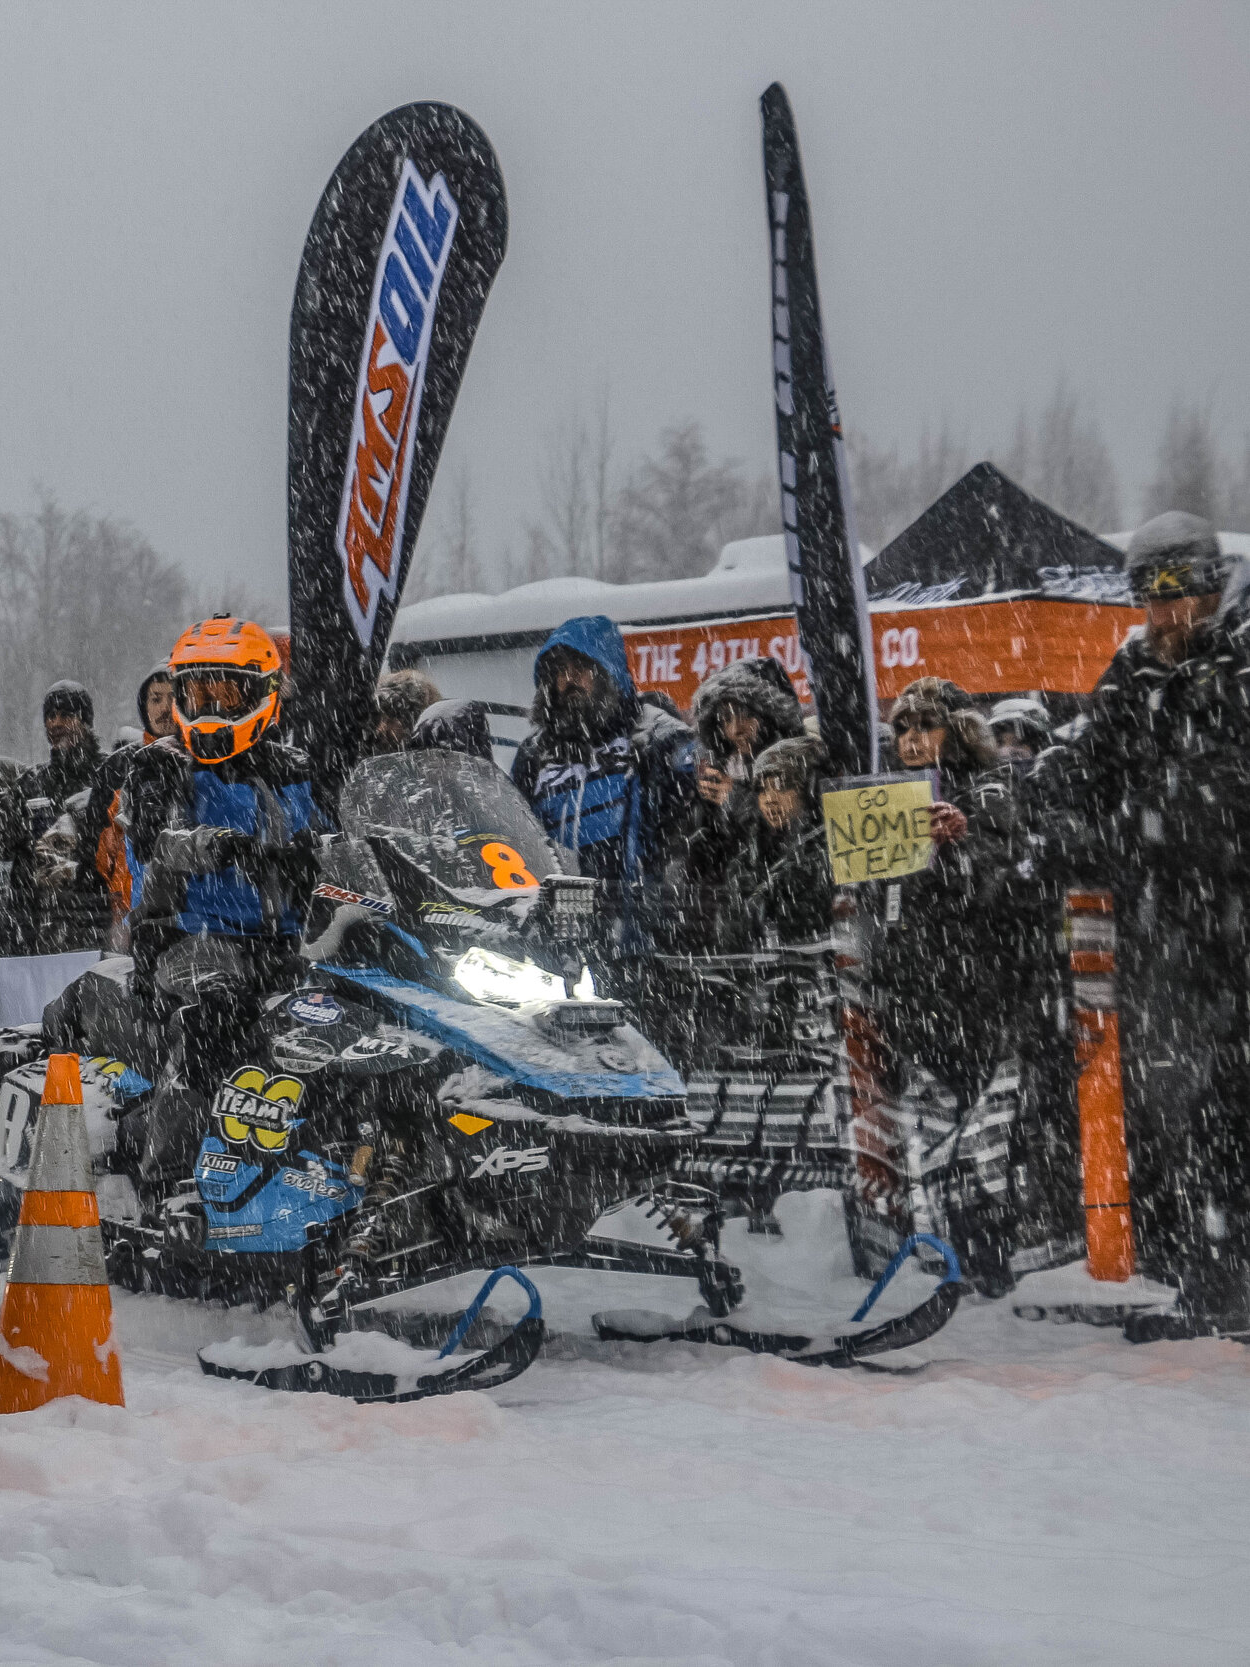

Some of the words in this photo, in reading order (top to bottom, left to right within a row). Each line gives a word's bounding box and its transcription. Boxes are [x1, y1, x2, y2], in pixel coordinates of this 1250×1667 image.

[337, 162, 456, 646] AMSOIL
[633, 643, 683, 684] THE
[880, 627, 927, 668] CO.
[857, 789, 888, 810] GO
[830, 806, 931, 852] NOME
[480, 842, 540, 890] 8
[312, 882, 395, 914] AMSOIL
[417, 901, 481, 915] TYSON
[354, 1036, 411, 1060] MTA
[221, 1087, 280, 1120] TEAM
[202, 1154, 237, 1171] Klim
[469, 1146, 550, 1179] XPS
